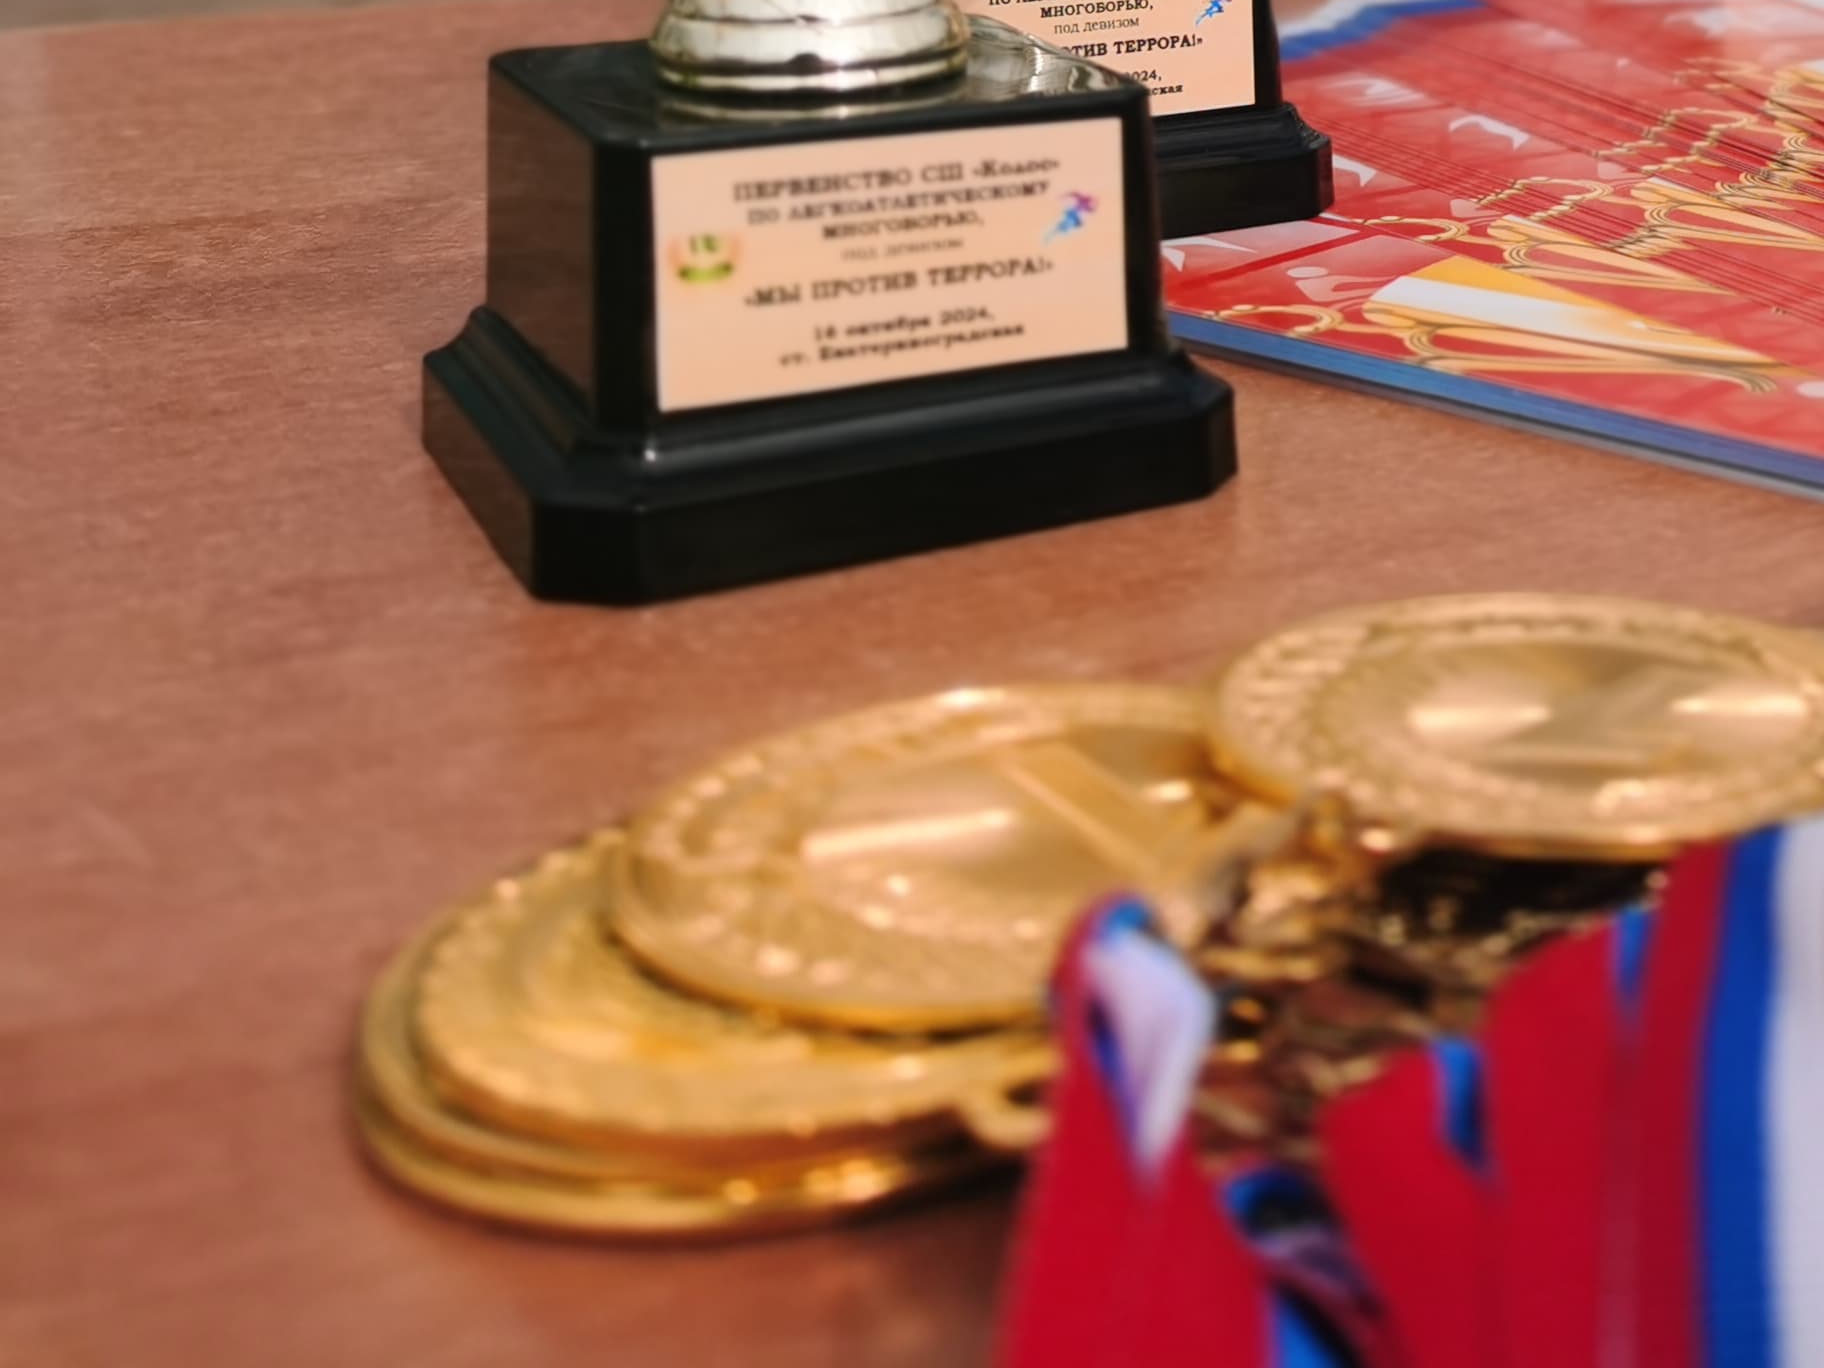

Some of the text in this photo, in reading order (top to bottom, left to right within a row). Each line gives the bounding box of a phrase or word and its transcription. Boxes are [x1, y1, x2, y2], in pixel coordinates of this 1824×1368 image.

[1054, 17, 1140, 35] под девизом
[1113, 34, 1203, 54] ТЕРРОРА!»
[732, 166, 914, 203] ПЕРВЕНСТВО
[920, 162, 964, 183] СШ
[746, 179, 1050, 226] ПО ЛЕГКОАТЛЕТИЧЕСКОМУ
[821, 209, 985, 241] МНОГОБОРЬЮ,
[744, 255, 1054, 307] «МЫ ПРОТИВ ТЕРРОРА!»
